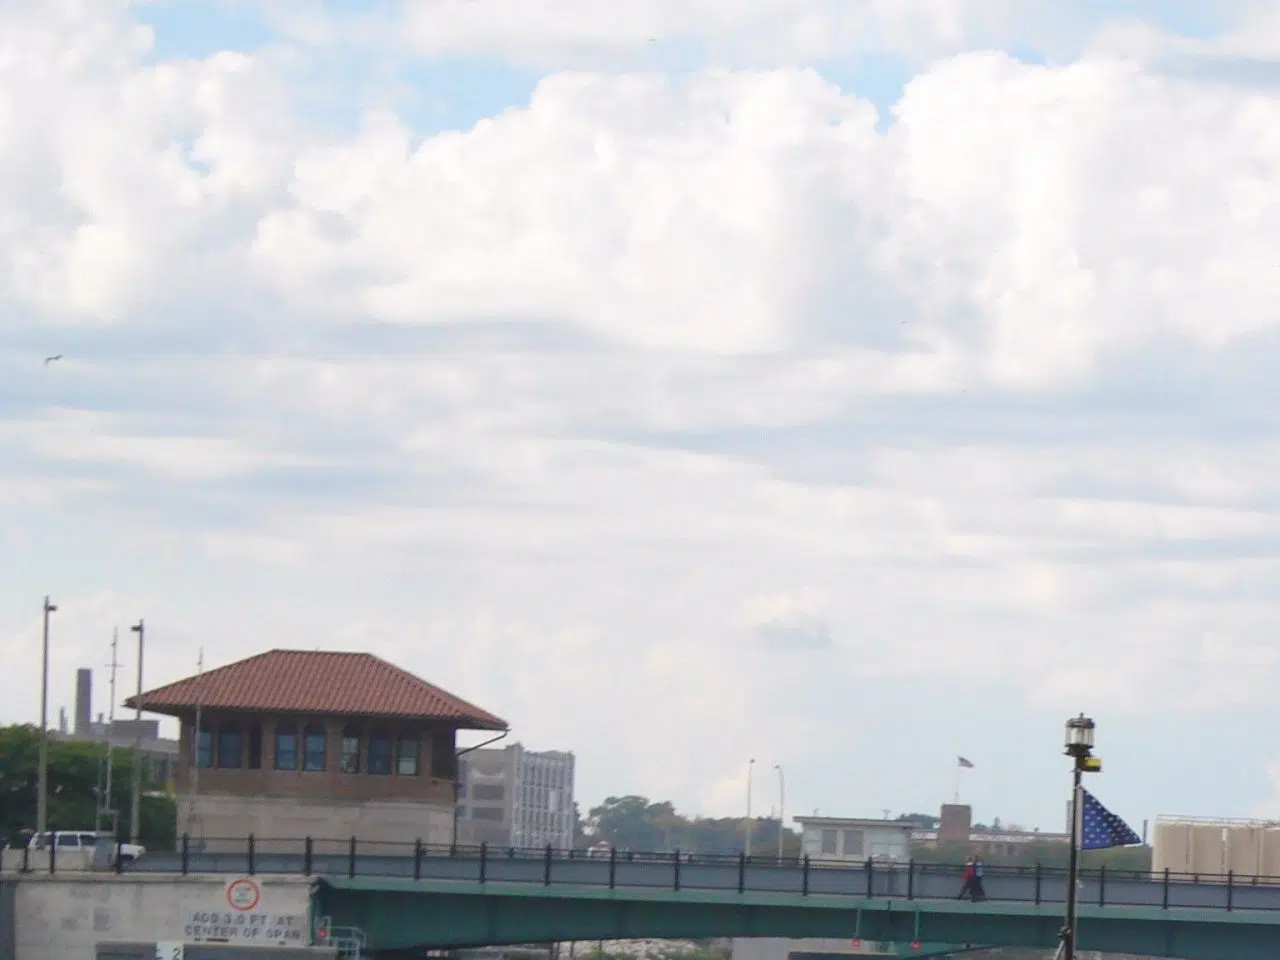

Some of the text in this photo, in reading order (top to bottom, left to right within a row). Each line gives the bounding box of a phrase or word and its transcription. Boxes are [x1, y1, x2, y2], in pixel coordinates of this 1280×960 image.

[276, 916, 293, 926] AT
[185, 925, 301, 940] CENTER OF SPAN
[172, 947, 180, 960] 2
